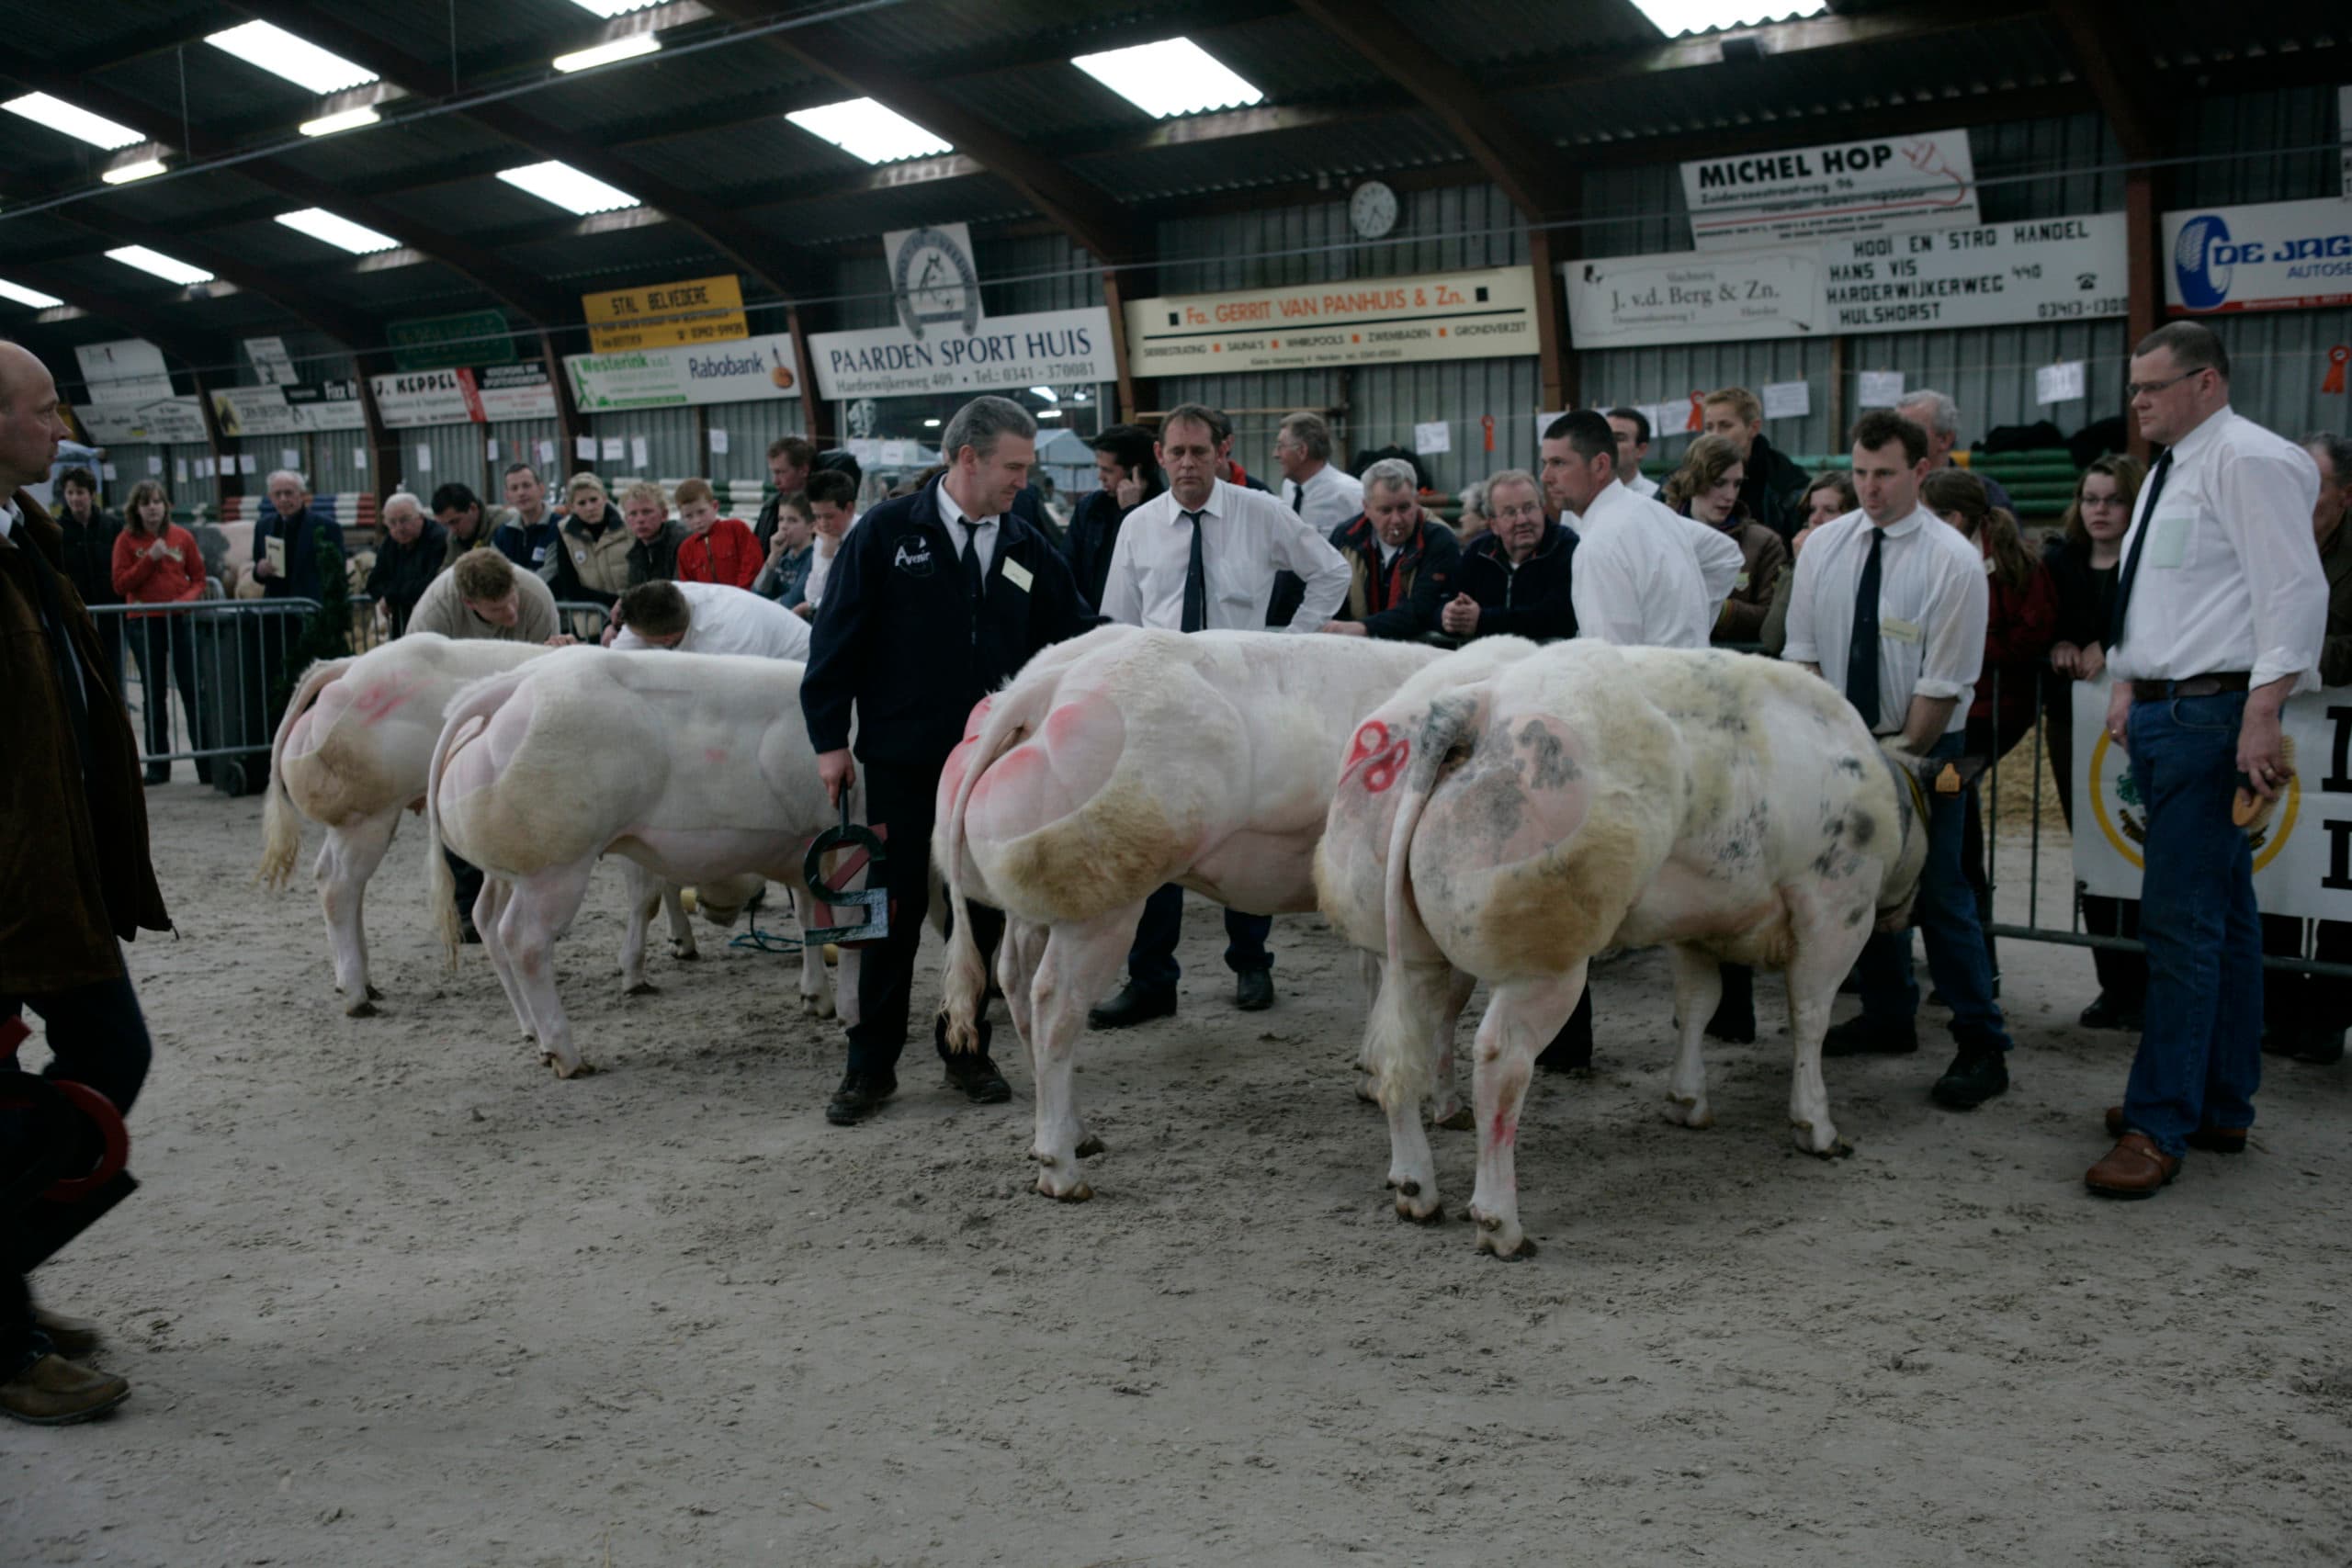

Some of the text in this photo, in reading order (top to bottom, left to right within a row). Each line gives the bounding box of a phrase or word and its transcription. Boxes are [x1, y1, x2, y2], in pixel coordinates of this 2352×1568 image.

[1699, 144, 1894, 188] MICHEL HOP
[1909, 235, 1933, 254] EN
[1947, 229, 1996, 250] STRO
[2014, 220, 2090, 243] HANDEL
[2213, 243, 2265, 265] DE
[1829, 263, 1875, 282] HANS
[611, 285, 709, 315] STAL BELVEDERE
[1611, 279, 1780, 312] J. v.d. Berg & Zn.
[1826, 275, 2005, 304] HARDERWIJKERWEG
[1186, 285, 1466, 325] Fa. GERRIT VAN PANHUIS & Zn.
[1839, 302, 1941, 325] HULSHORST
[1454, 321, 1527, 336] GRONDVERZET
[688, 350, 764, 379] Rabobank
[831, 327, 1092, 373] PAARDEN SPORT HUIS
[376, 379, 390, 397] J.
[396, 372, 457, 393] KEPPEL
